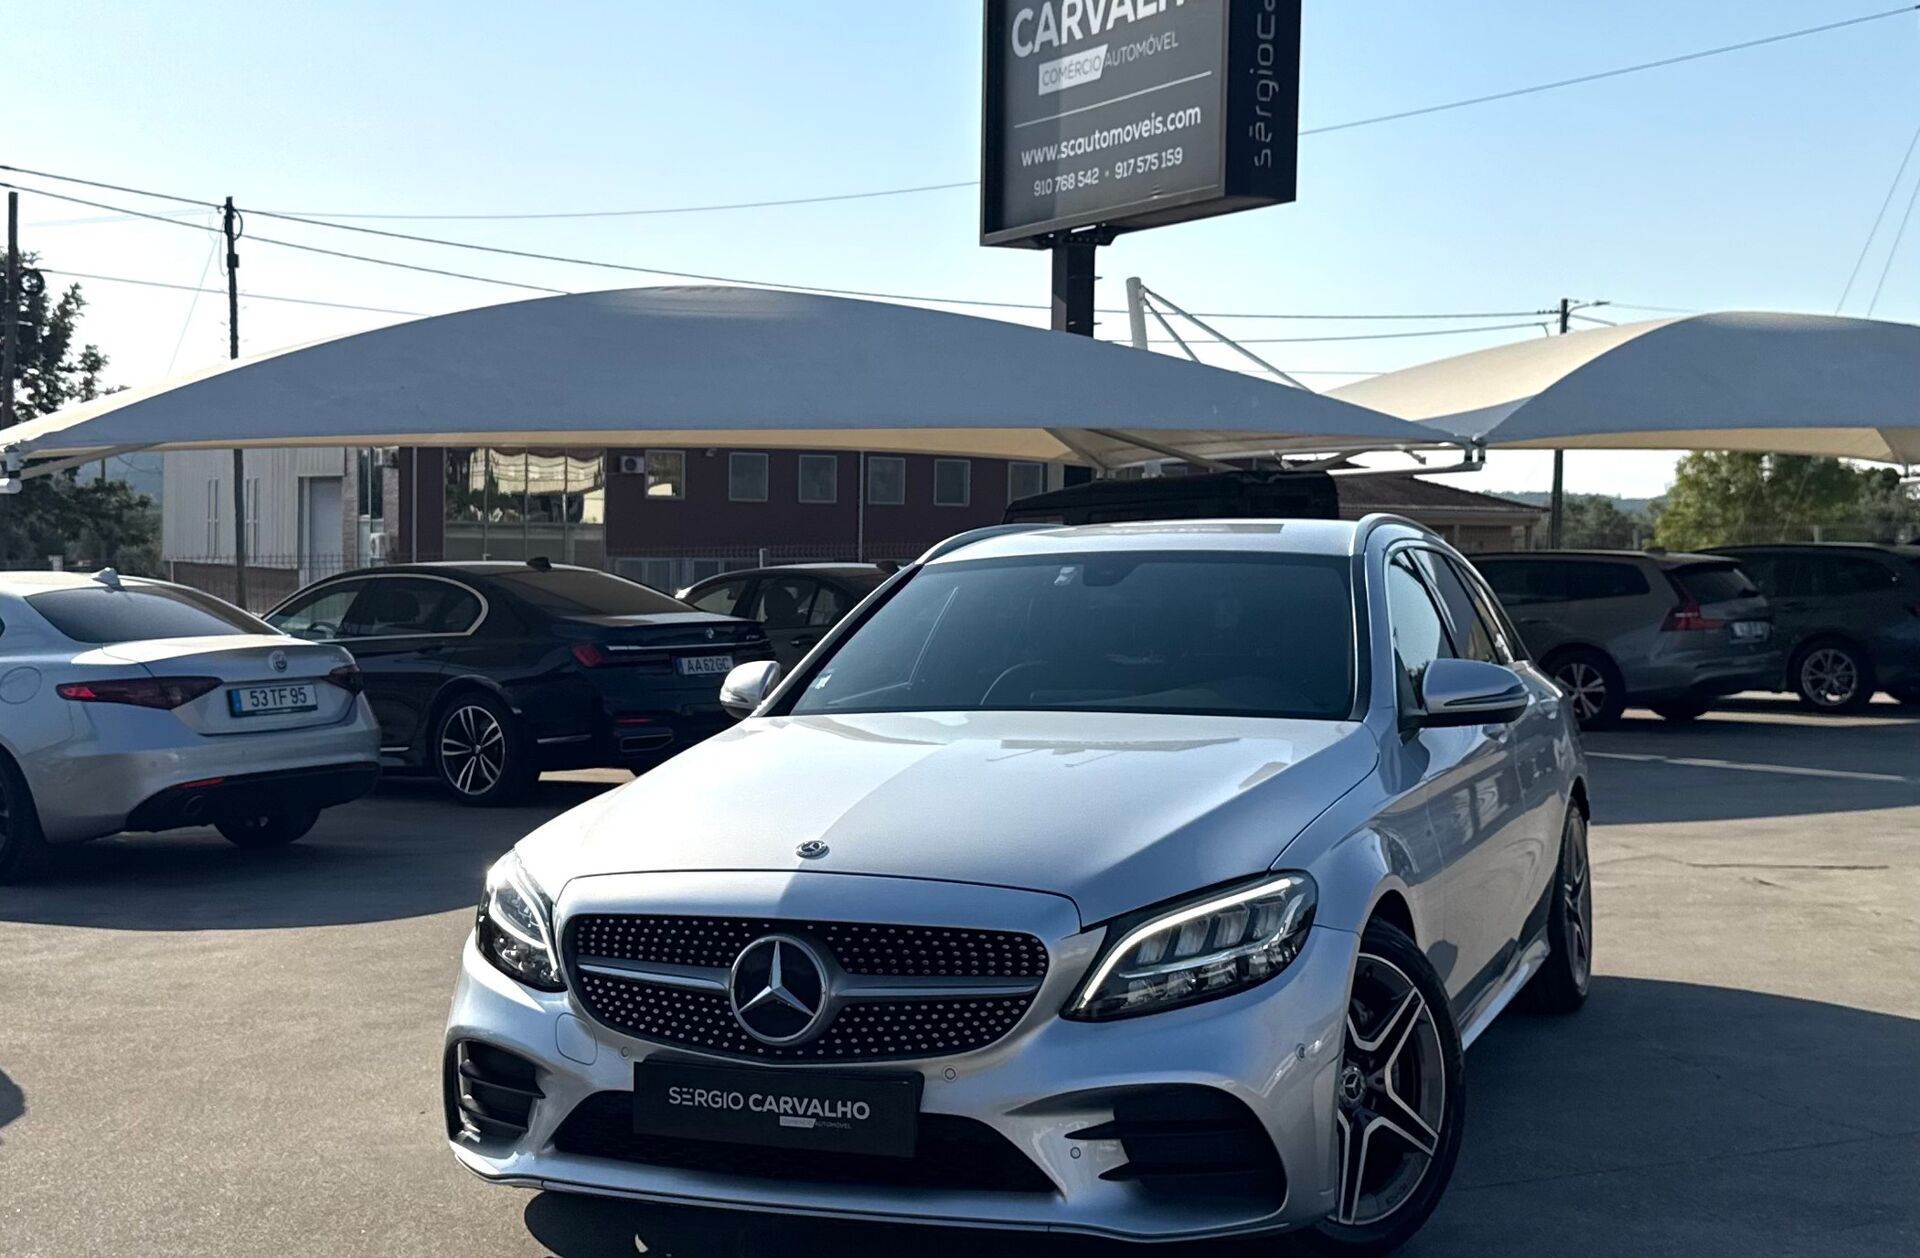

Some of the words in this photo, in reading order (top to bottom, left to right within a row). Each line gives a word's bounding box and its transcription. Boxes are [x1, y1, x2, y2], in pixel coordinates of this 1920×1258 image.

[1012, 0, 1184, 58] CARVA
[1042, 54, 1101, 86] COMÉRCIO
[1104, 31, 1179, 67] AUTOMÓVEL
[1021, 106, 1201, 166] www.scautomoveis.com
[1033, 178, 1053, 197] 910
[1055, 173, 1076, 192] 768
[1077, 168, 1099, 188] 542
[1115, 159, 1135, 179] 917
[1137, 153, 1159, 174] 575
[1161, 147, 1183, 168] 159
[748, 1093, 871, 1120] CARVALHO
